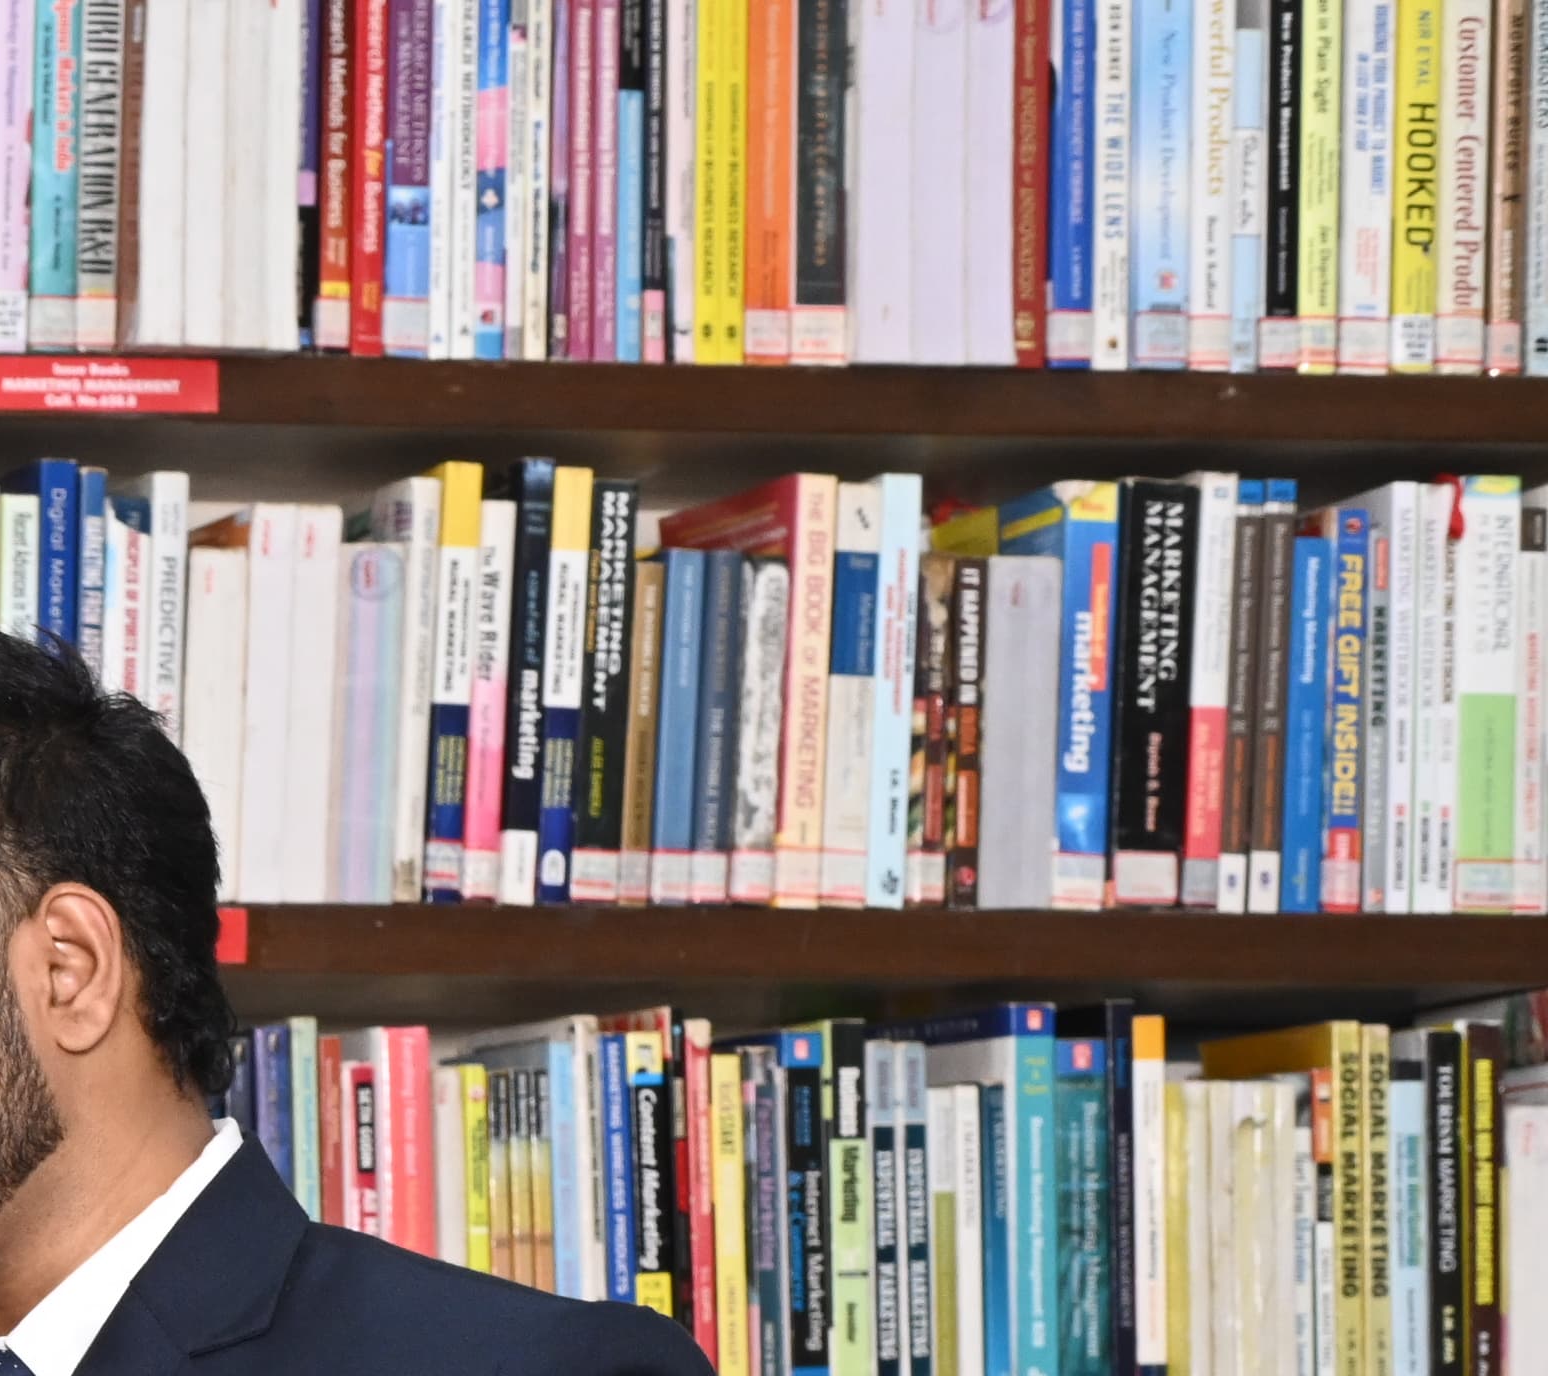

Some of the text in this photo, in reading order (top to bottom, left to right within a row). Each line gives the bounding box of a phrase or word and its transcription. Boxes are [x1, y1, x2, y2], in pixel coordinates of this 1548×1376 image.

[80, 60, 119, 274] GENERATION R&D
[1105, 93, 1125, 240] THE WIDE LENS
[1406, 103, 1437, 247] HOOKED
[1136, 500, 1163, 710] MANAGEMENT
[1160, 503, 1185, 679] MARKETING
[1065, 612, 1094, 772] marketing
[1333, 554, 1363, 815] FREE GIFT INSIDE!!
[637, 1089, 663, 1270] Content Marketing
[1370, 1054, 1387, 1298] SOCIAL MARKETING
